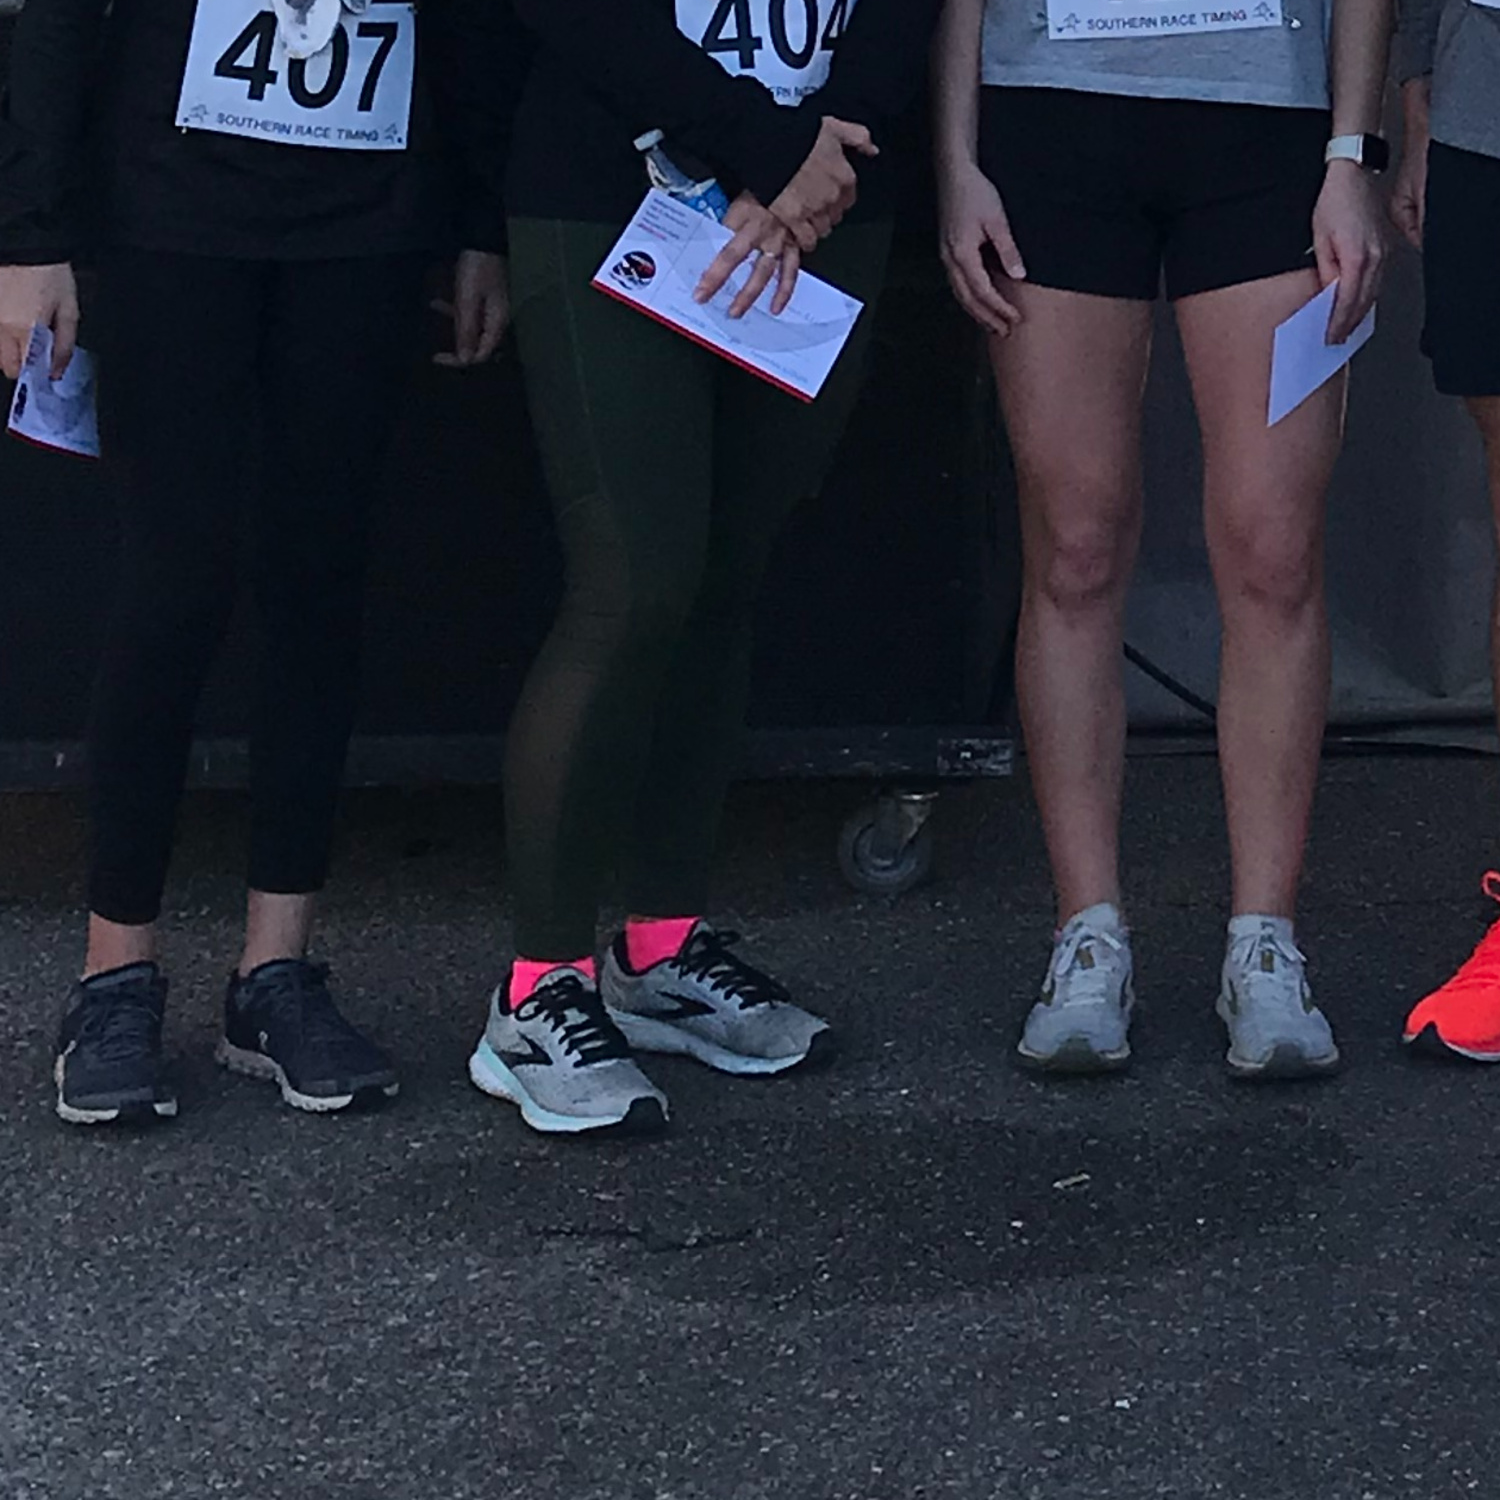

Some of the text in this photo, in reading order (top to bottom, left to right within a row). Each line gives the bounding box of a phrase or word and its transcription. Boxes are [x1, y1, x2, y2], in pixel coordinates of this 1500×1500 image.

[1086, 9, 1248, 31] SOUTHERN RACE TIMING
[213, 10, 399, 112] 407
[216, 112, 379, 141] SOUTHERN RACE TIMING
